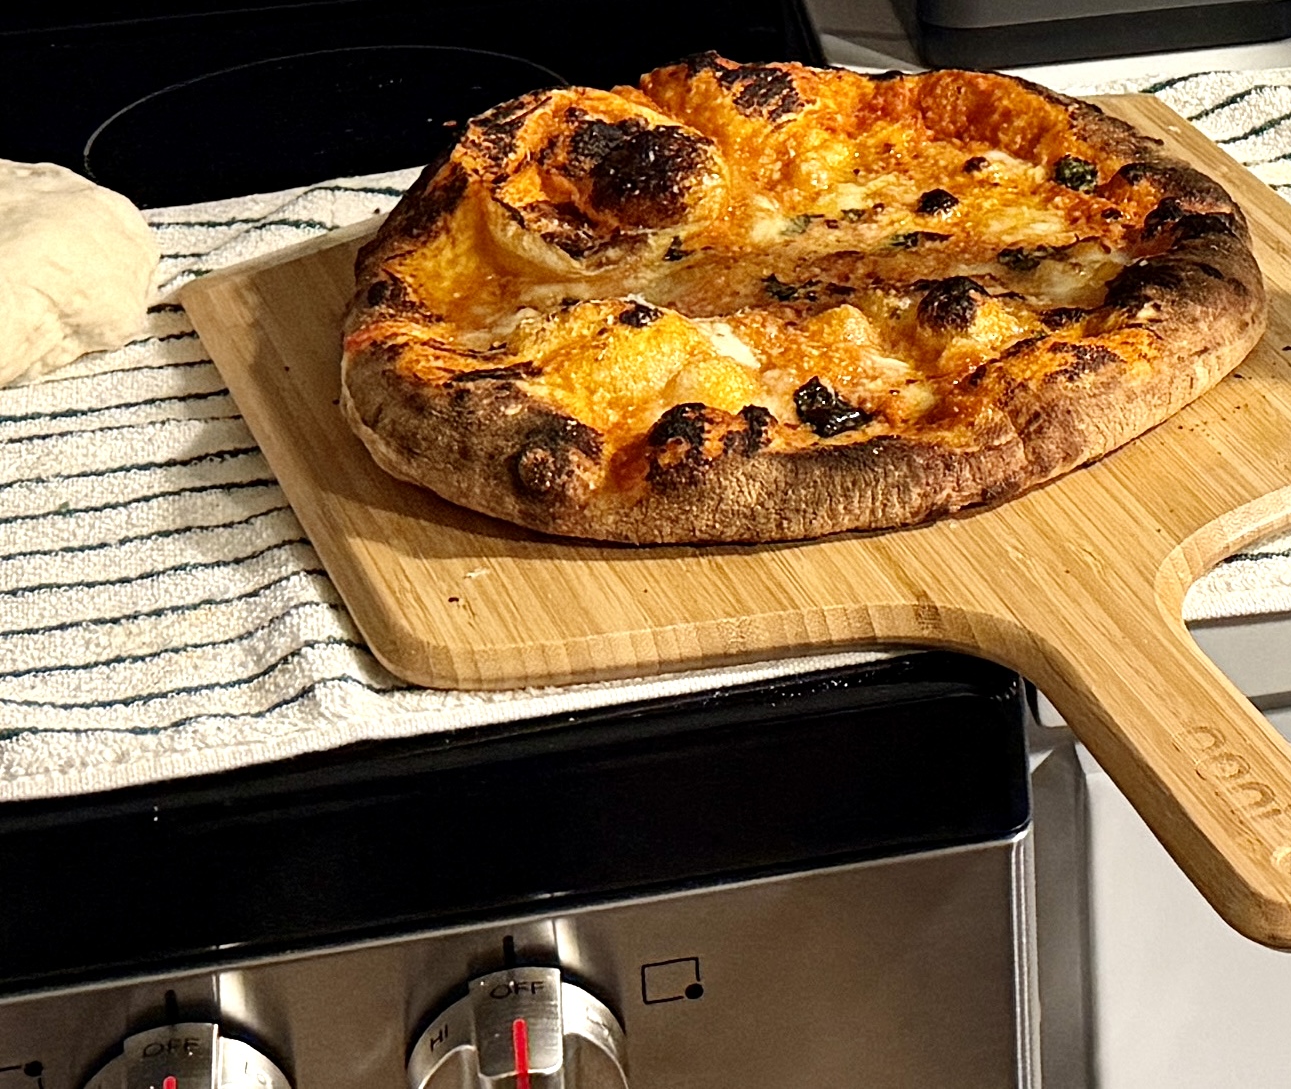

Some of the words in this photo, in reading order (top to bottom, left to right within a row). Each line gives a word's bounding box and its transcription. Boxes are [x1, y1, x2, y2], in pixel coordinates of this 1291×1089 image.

[489, 980, 545, 1000] OFF
[142, 1037, 201, 1059] OFF
[429, 1023, 449, 1052] HI
